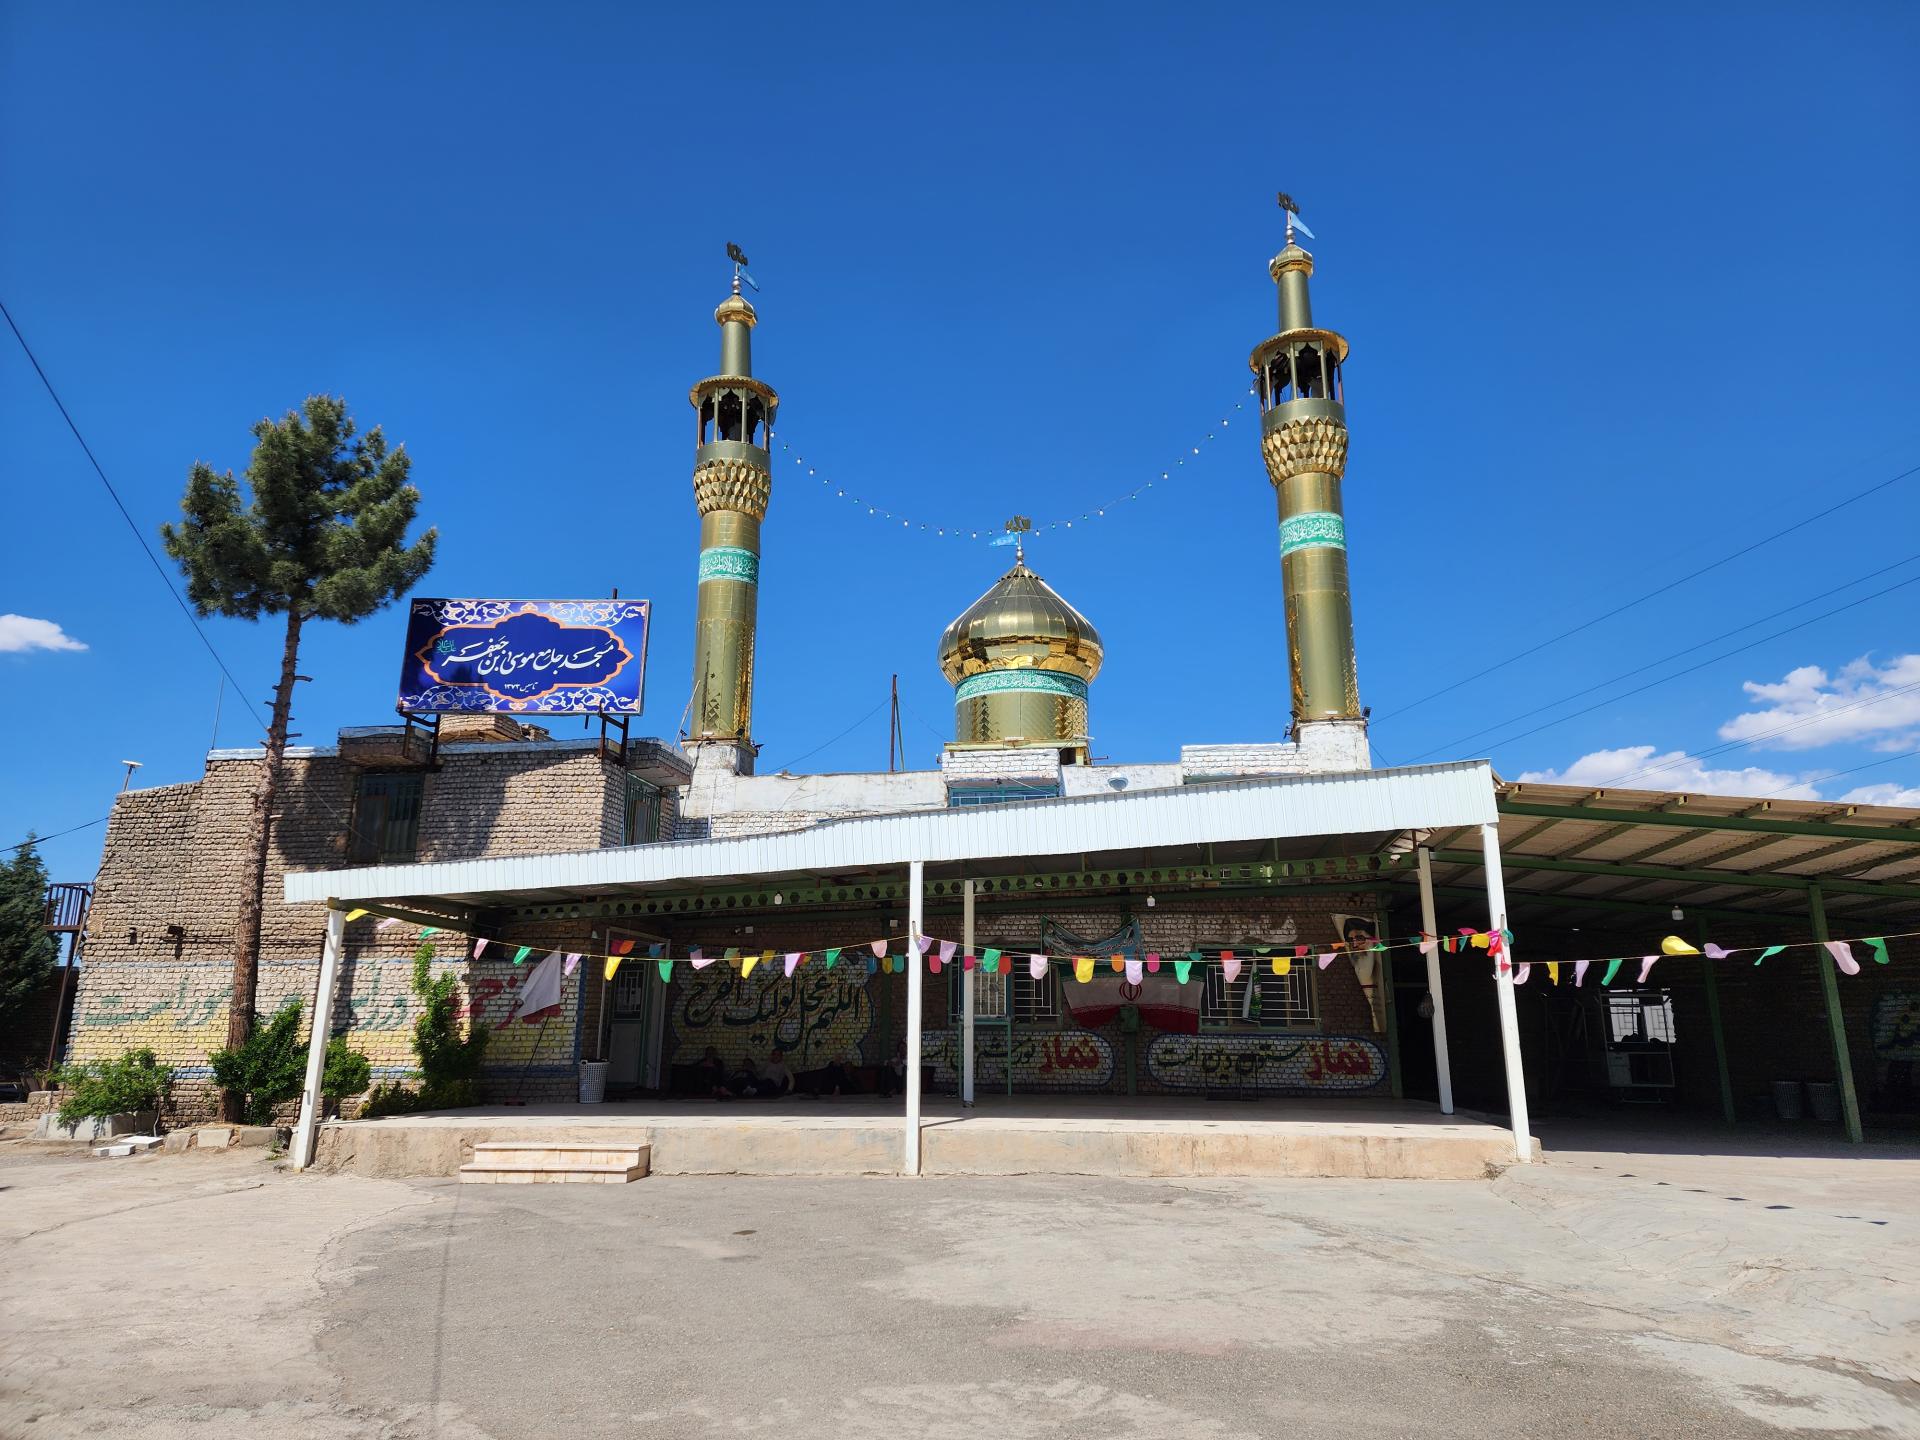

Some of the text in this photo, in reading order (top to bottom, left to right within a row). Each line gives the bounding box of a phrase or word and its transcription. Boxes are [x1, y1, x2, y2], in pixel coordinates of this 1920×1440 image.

[441, 635, 510, 667] جعفر
[532, 648, 564, 675] جامع
[558, 639, 614, 669] مسجد
[1039, 1034, 1101, 1073] نماز
[1305, 1040, 1372, 1081] نماز
